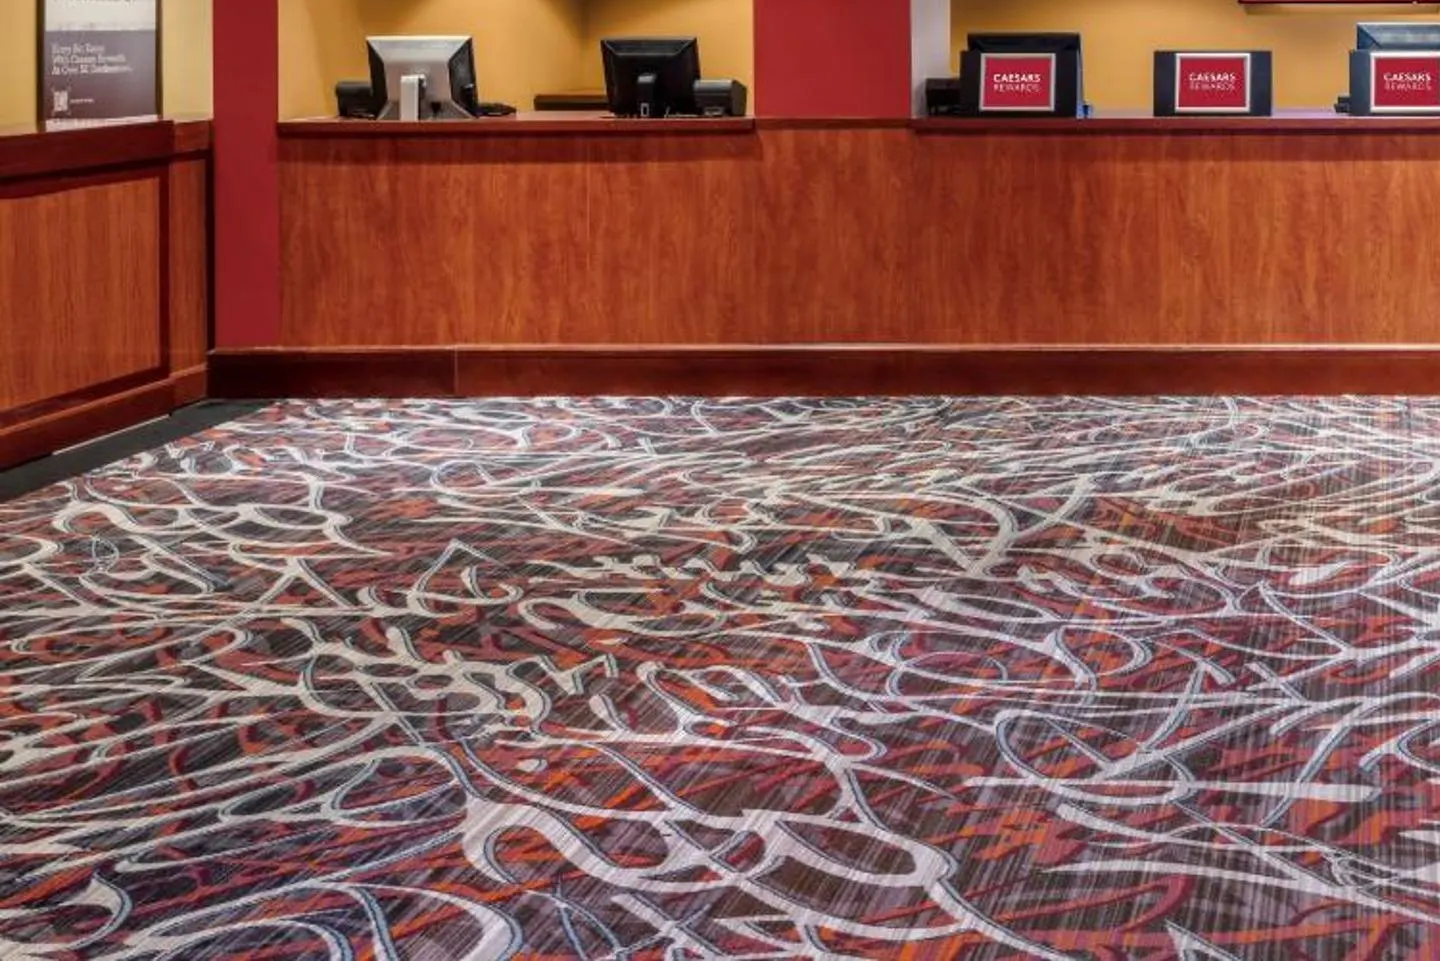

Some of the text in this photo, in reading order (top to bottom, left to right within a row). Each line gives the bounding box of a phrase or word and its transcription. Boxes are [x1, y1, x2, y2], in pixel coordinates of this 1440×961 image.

[993, 73, 1041, 83] CAESARS
[1189, 73, 1236, 82] CAESARS
[1384, 72, 1431, 82] CAESARS
